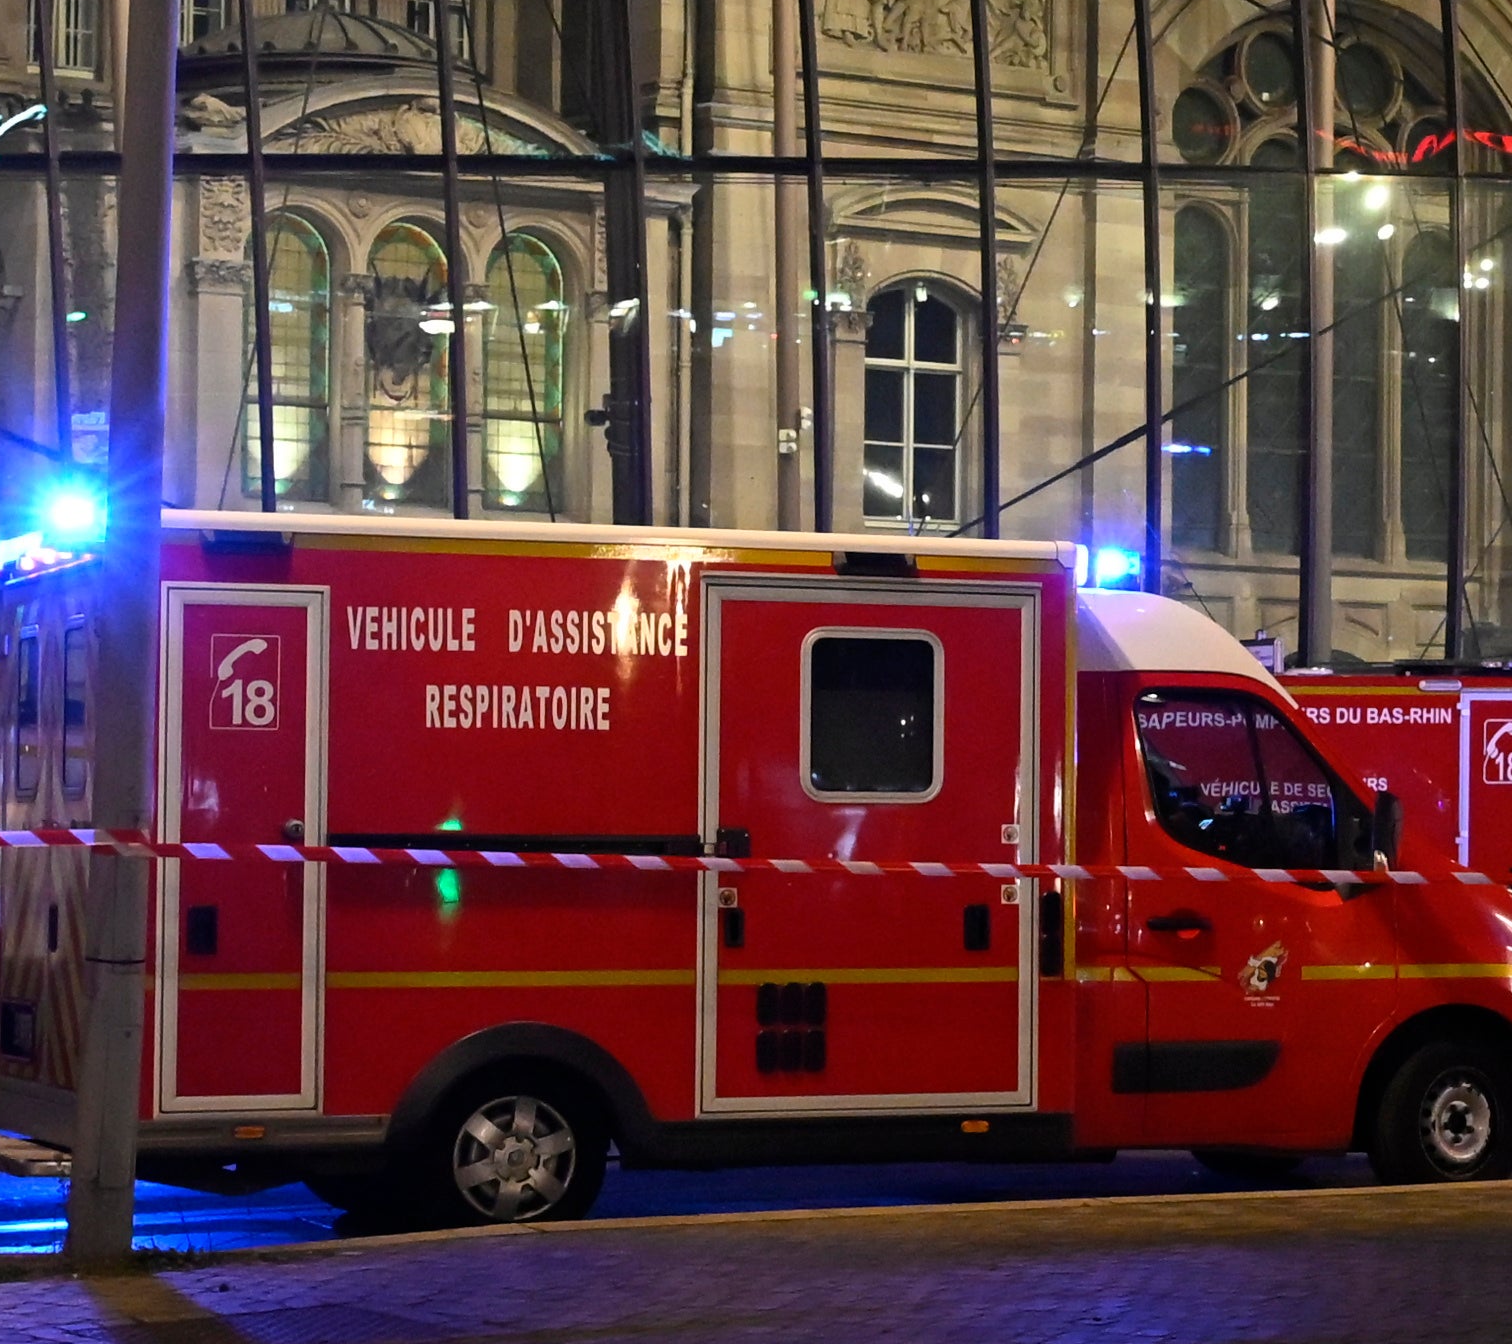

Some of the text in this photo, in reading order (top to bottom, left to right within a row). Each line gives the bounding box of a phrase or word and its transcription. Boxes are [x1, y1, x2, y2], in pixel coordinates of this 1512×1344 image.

[346, 605, 689, 657] VEHICULE D'ASSISTANCE
[221, 679, 275, 725] 18
[425, 684, 611, 731] RESPIRATOIRE
[1336, 707, 1361, 724] DU
[1366, 707, 1452, 725] BAS-RHIN
[1200, 777, 1280, 797] VÉHICUE
[1284, 782, 1303, 797] DE
